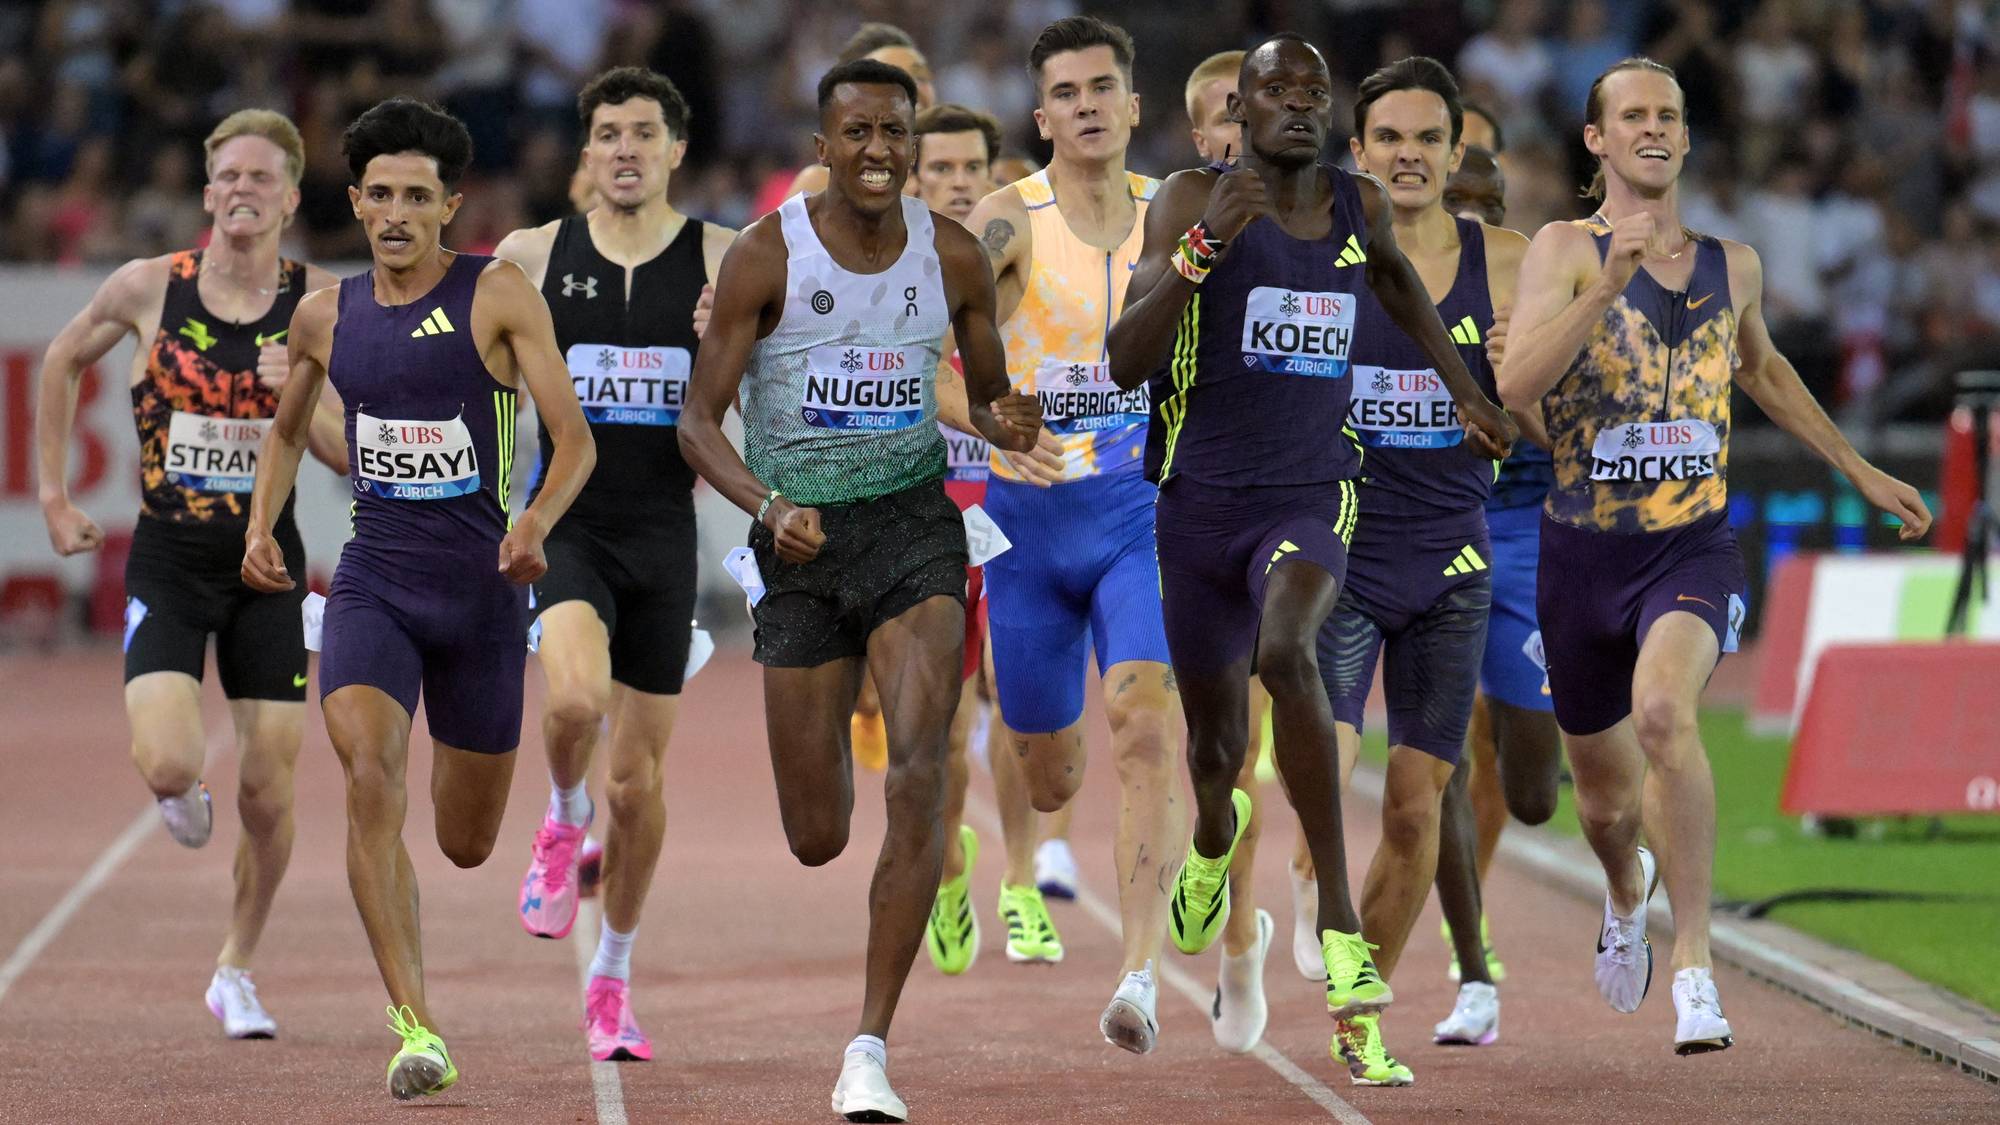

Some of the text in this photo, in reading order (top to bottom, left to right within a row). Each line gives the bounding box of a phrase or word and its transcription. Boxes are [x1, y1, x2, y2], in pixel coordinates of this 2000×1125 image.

[1305, 296, 1342, 316] UBS
[1250, 320, 1349, 356] KOECH
[622, 351, 663, 369] UBS
[867, 351, 905, 371] UBS
[1284, 359, 1333, 375] ZURICH
[805, 375, 921, 408] NUGUSE
[1397, 373, 1440, 392] UBS
[605, 410, 646, 422] ZURICH
[846, 414, 896, 427] ZURICH
[1074, 413, 1125, 431] ZURICH
[1348, 398, 1461, 428] KESSLER
[222, 424, 261, 442] UBS
[400, 426, 444, 445] UBS
[1380, 433, 1432, 446] ZURICH
[1649, 425, 1692, 446] UBS
[360, 446, 476, 479] ESSAYI
[393, 485, 444, 498] ZURICH
